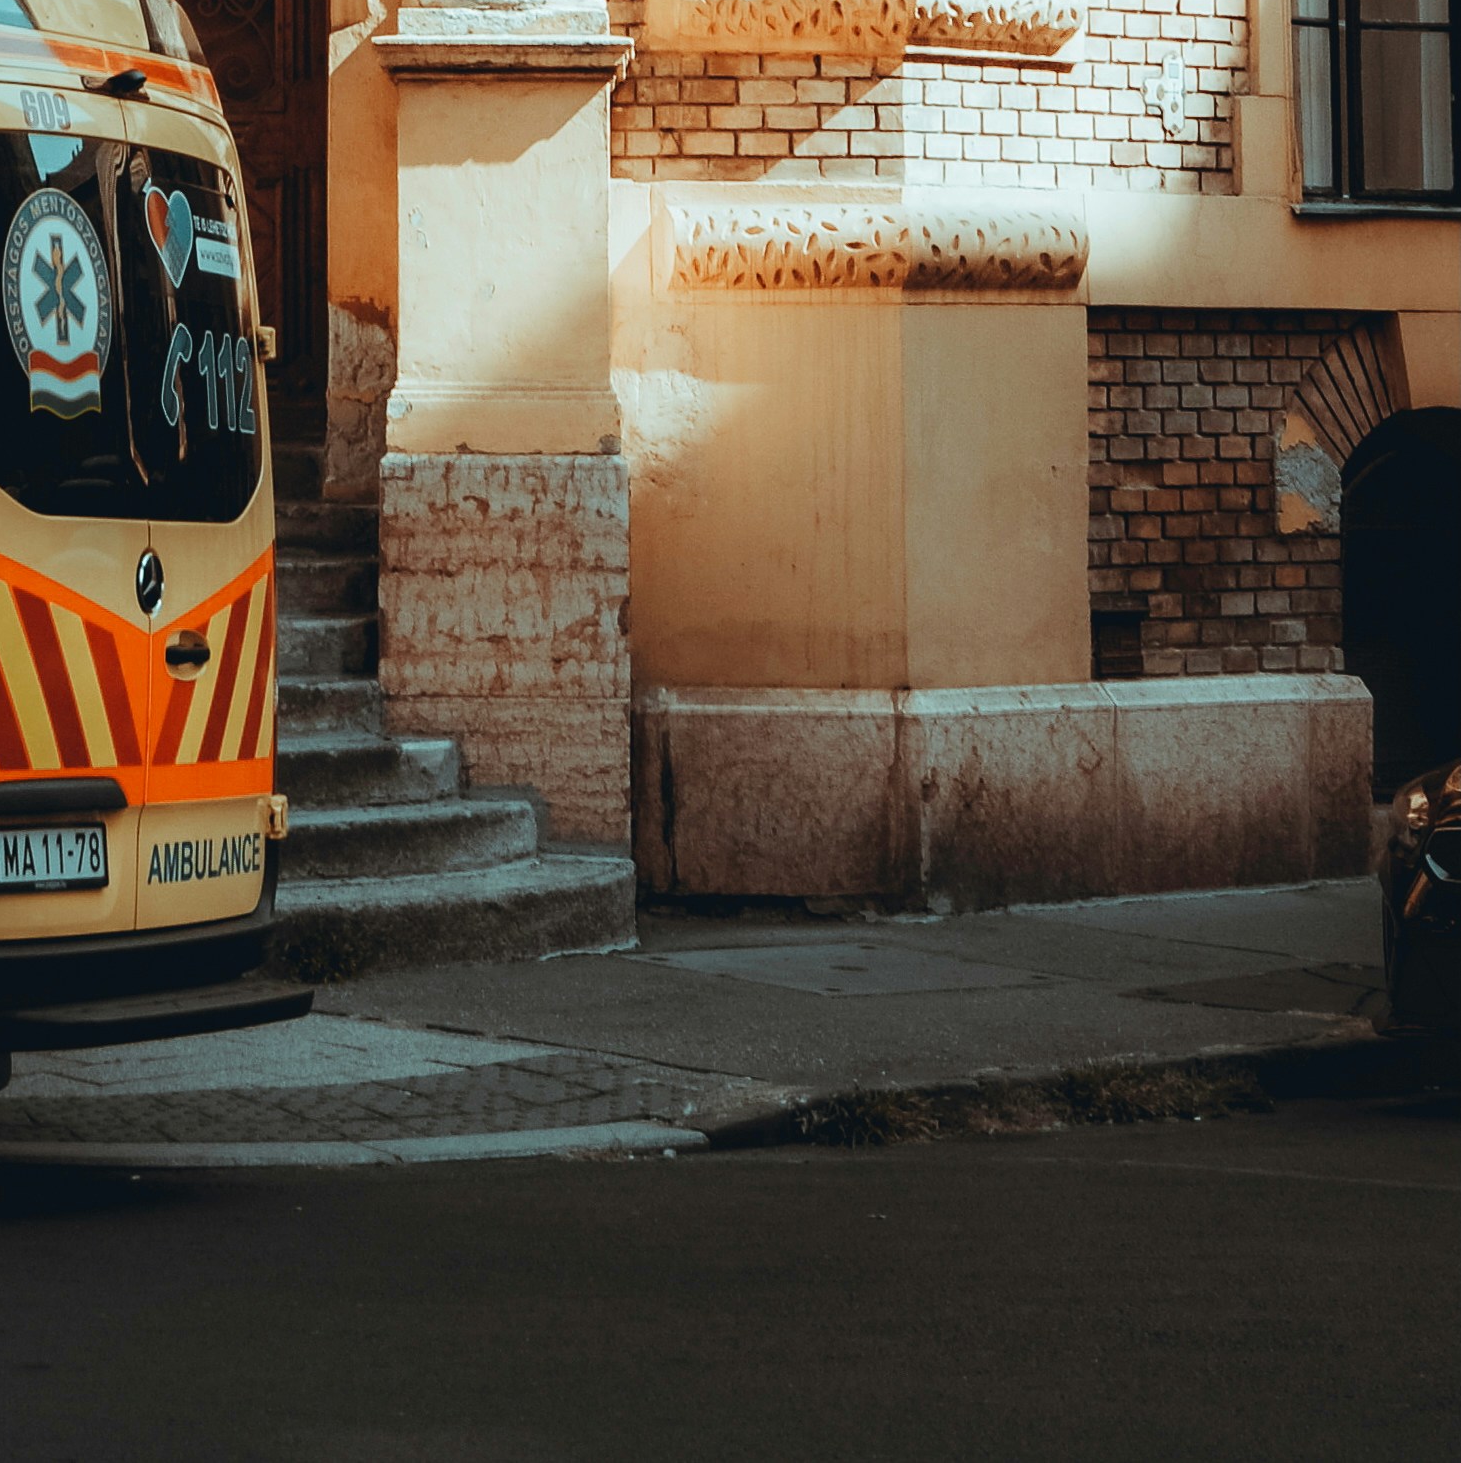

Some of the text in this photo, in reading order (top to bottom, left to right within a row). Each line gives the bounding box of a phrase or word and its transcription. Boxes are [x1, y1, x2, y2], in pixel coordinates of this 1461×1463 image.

[20, 89, 71, 131] 609
[198, 330, 257, 435] 112
[3, 834, 37, 877] MA
[42, 831, 101, 875] 11-78
[147, 831, 261, 886] AMBULANCE
